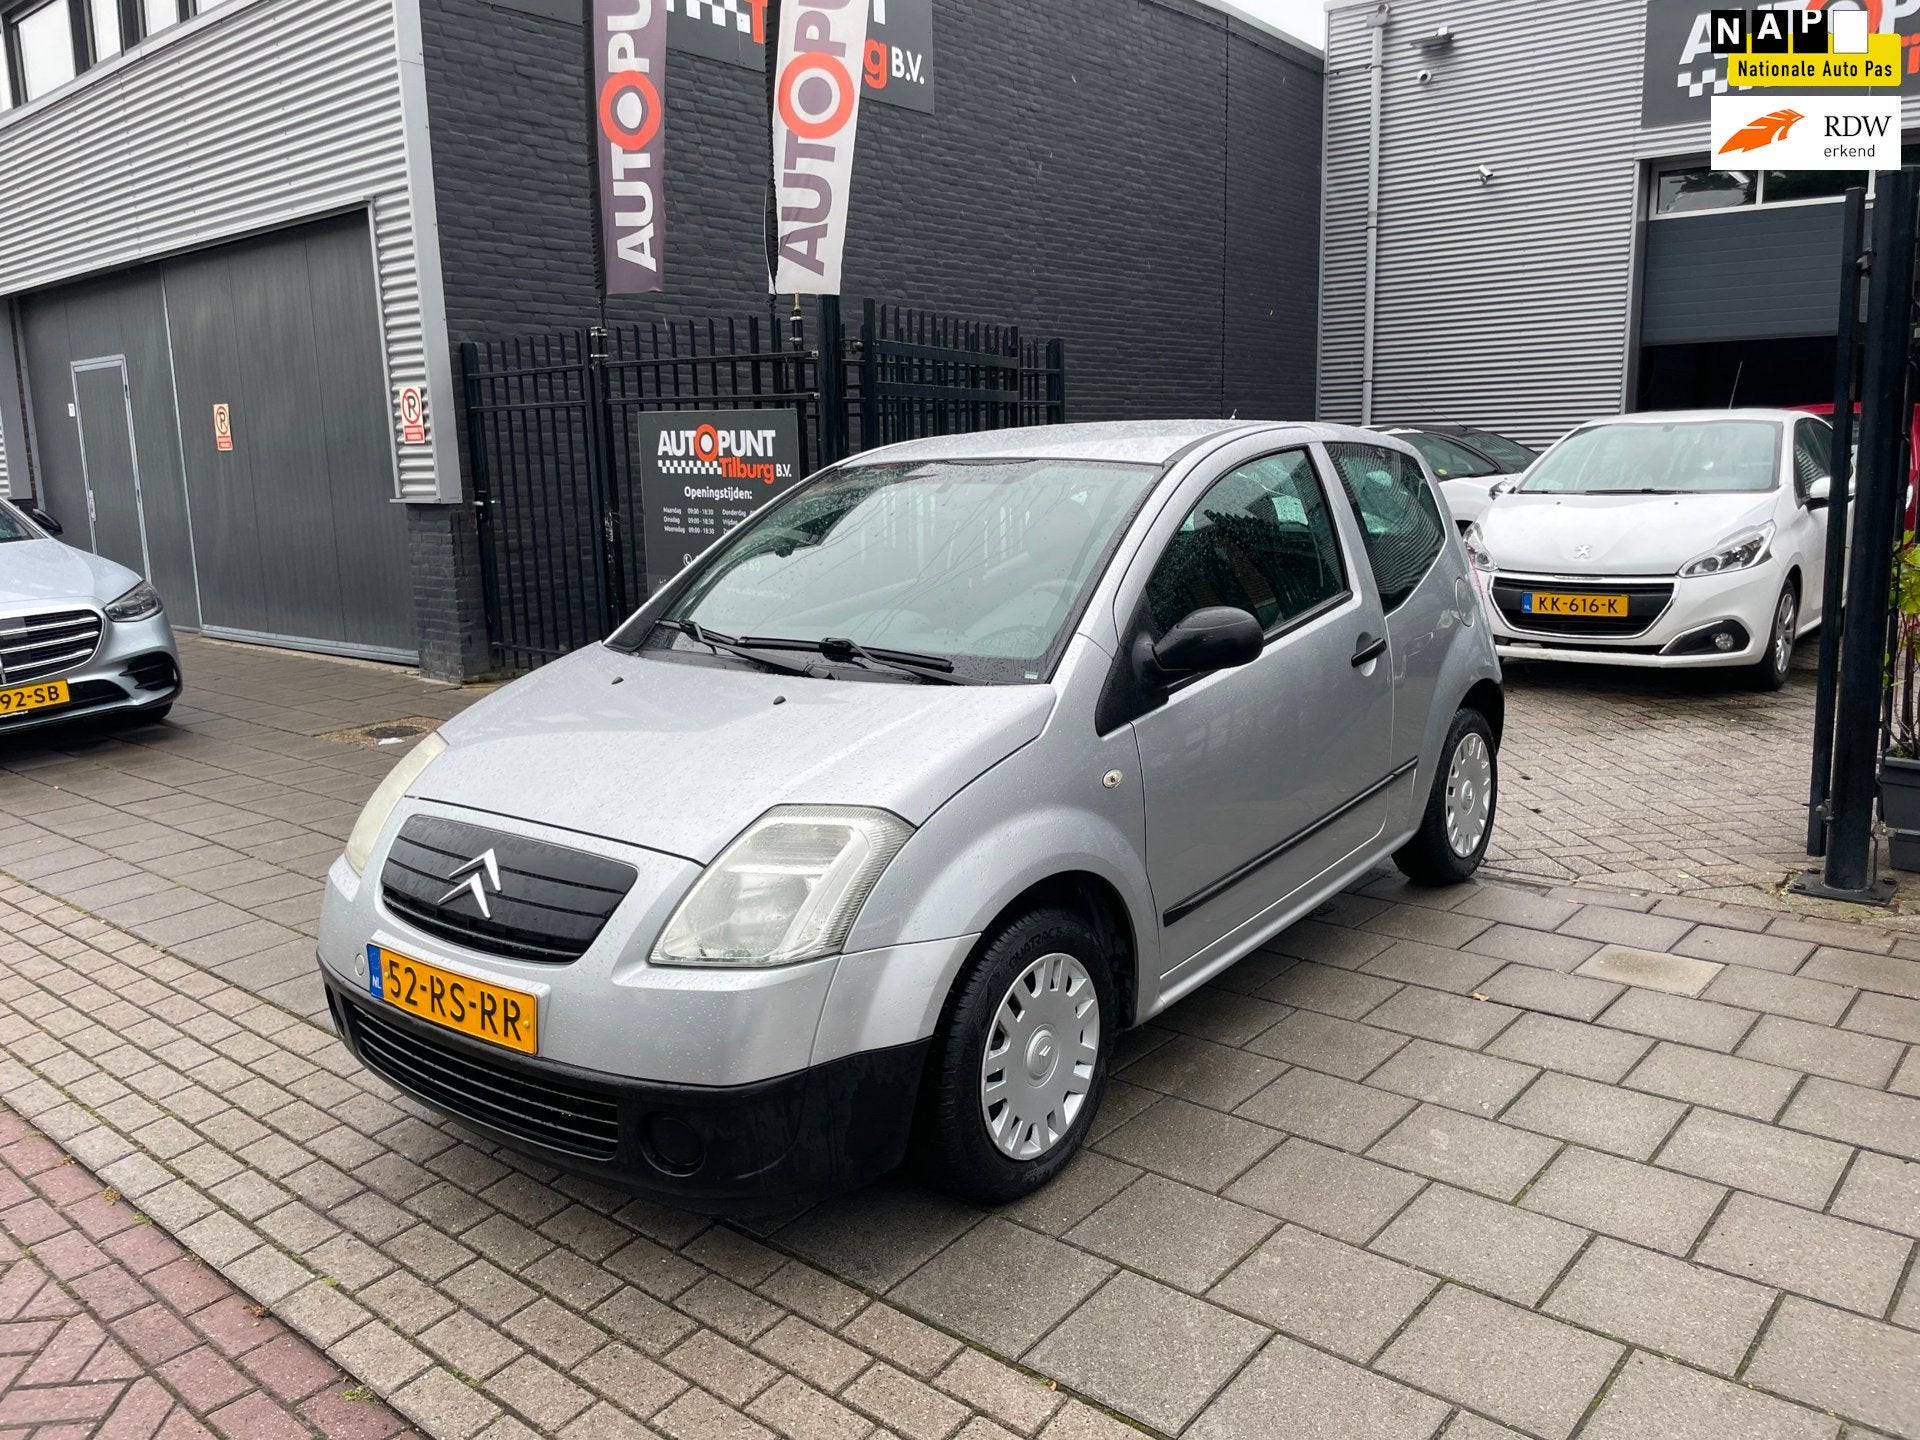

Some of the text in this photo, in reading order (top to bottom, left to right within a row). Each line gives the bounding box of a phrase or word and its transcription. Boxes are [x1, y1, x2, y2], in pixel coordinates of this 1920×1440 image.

[891, 46, 925, 85] B.V.
[657, 423, 776, 462] AUTOPUNT
[719, 456, 792, 485] Tilburg B.V.
[684, 486, 753, 501] Openingstijden:
[1539, 597, 1618, 613] KK-616-K
[0, 685, 60, 710] 92-SB
[372, 959, 522, 1041] NL 52-RS-RR
